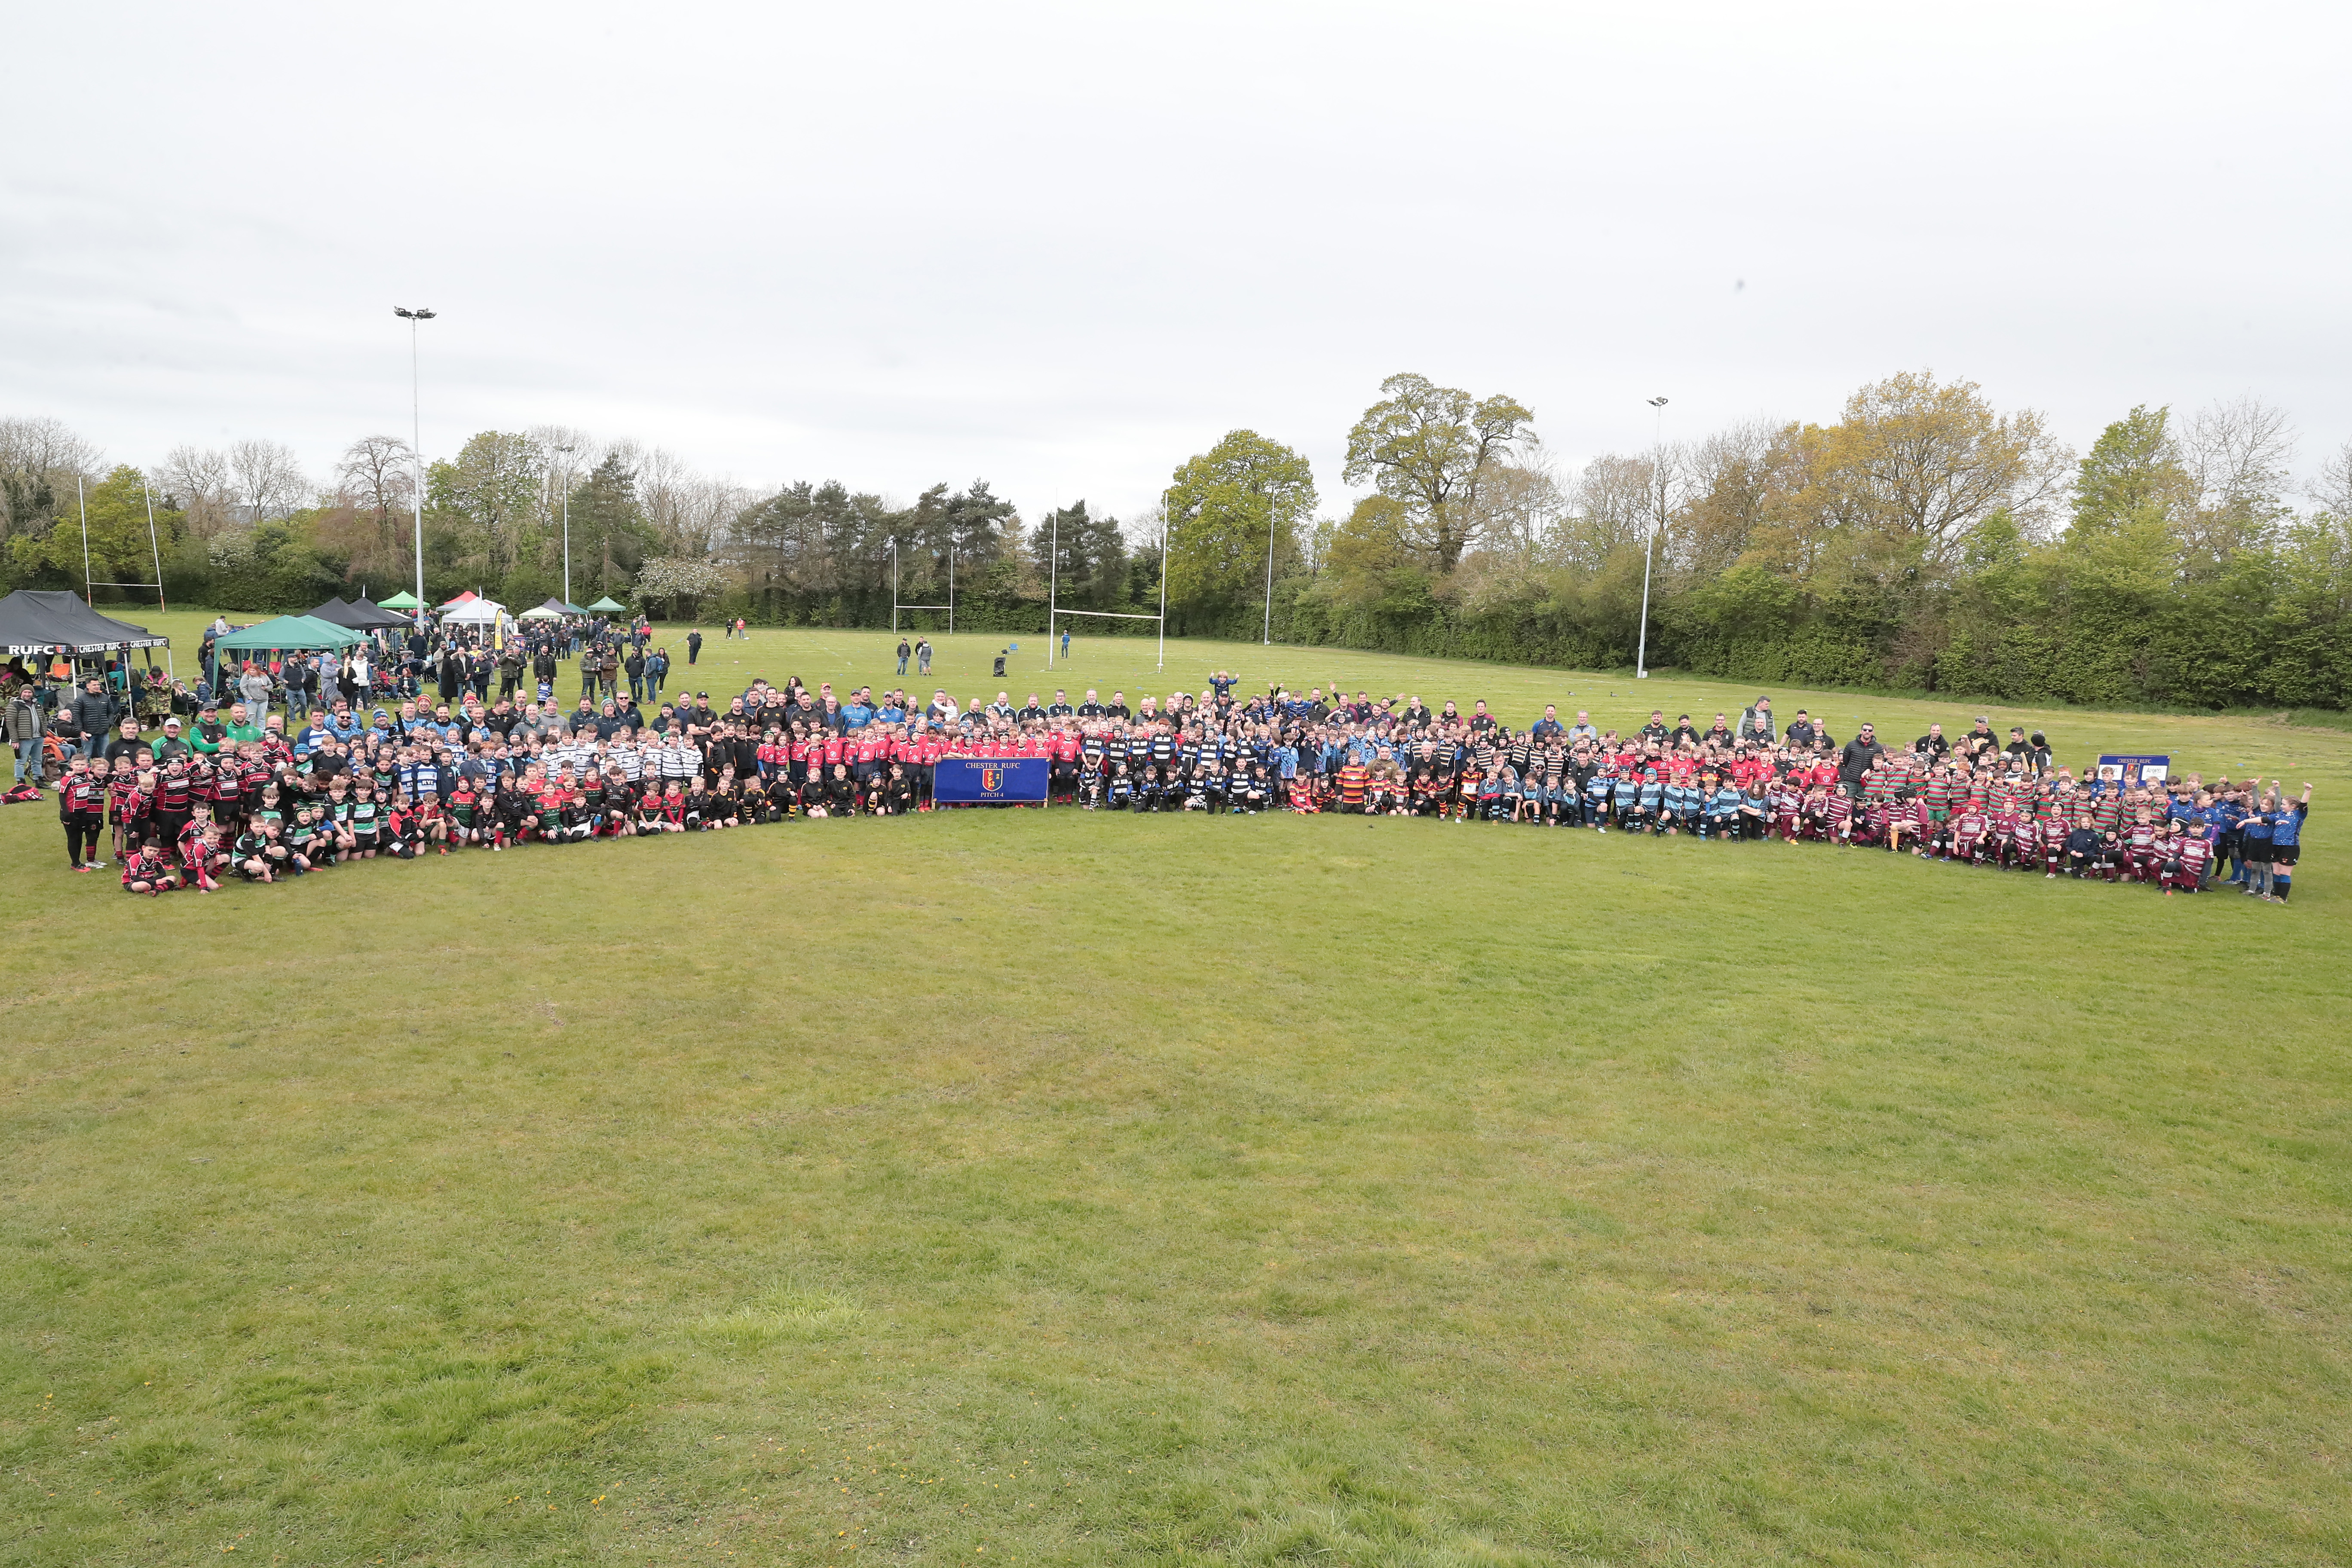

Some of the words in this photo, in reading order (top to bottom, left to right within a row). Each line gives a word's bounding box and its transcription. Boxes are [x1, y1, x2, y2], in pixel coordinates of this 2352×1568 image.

[79, 643, 105, 653] CHESTER
[107, 642, 122, 651] RUFC
[130, 639, 152, 648] CHESTER
[9, 645, 54, 655] RUFC
